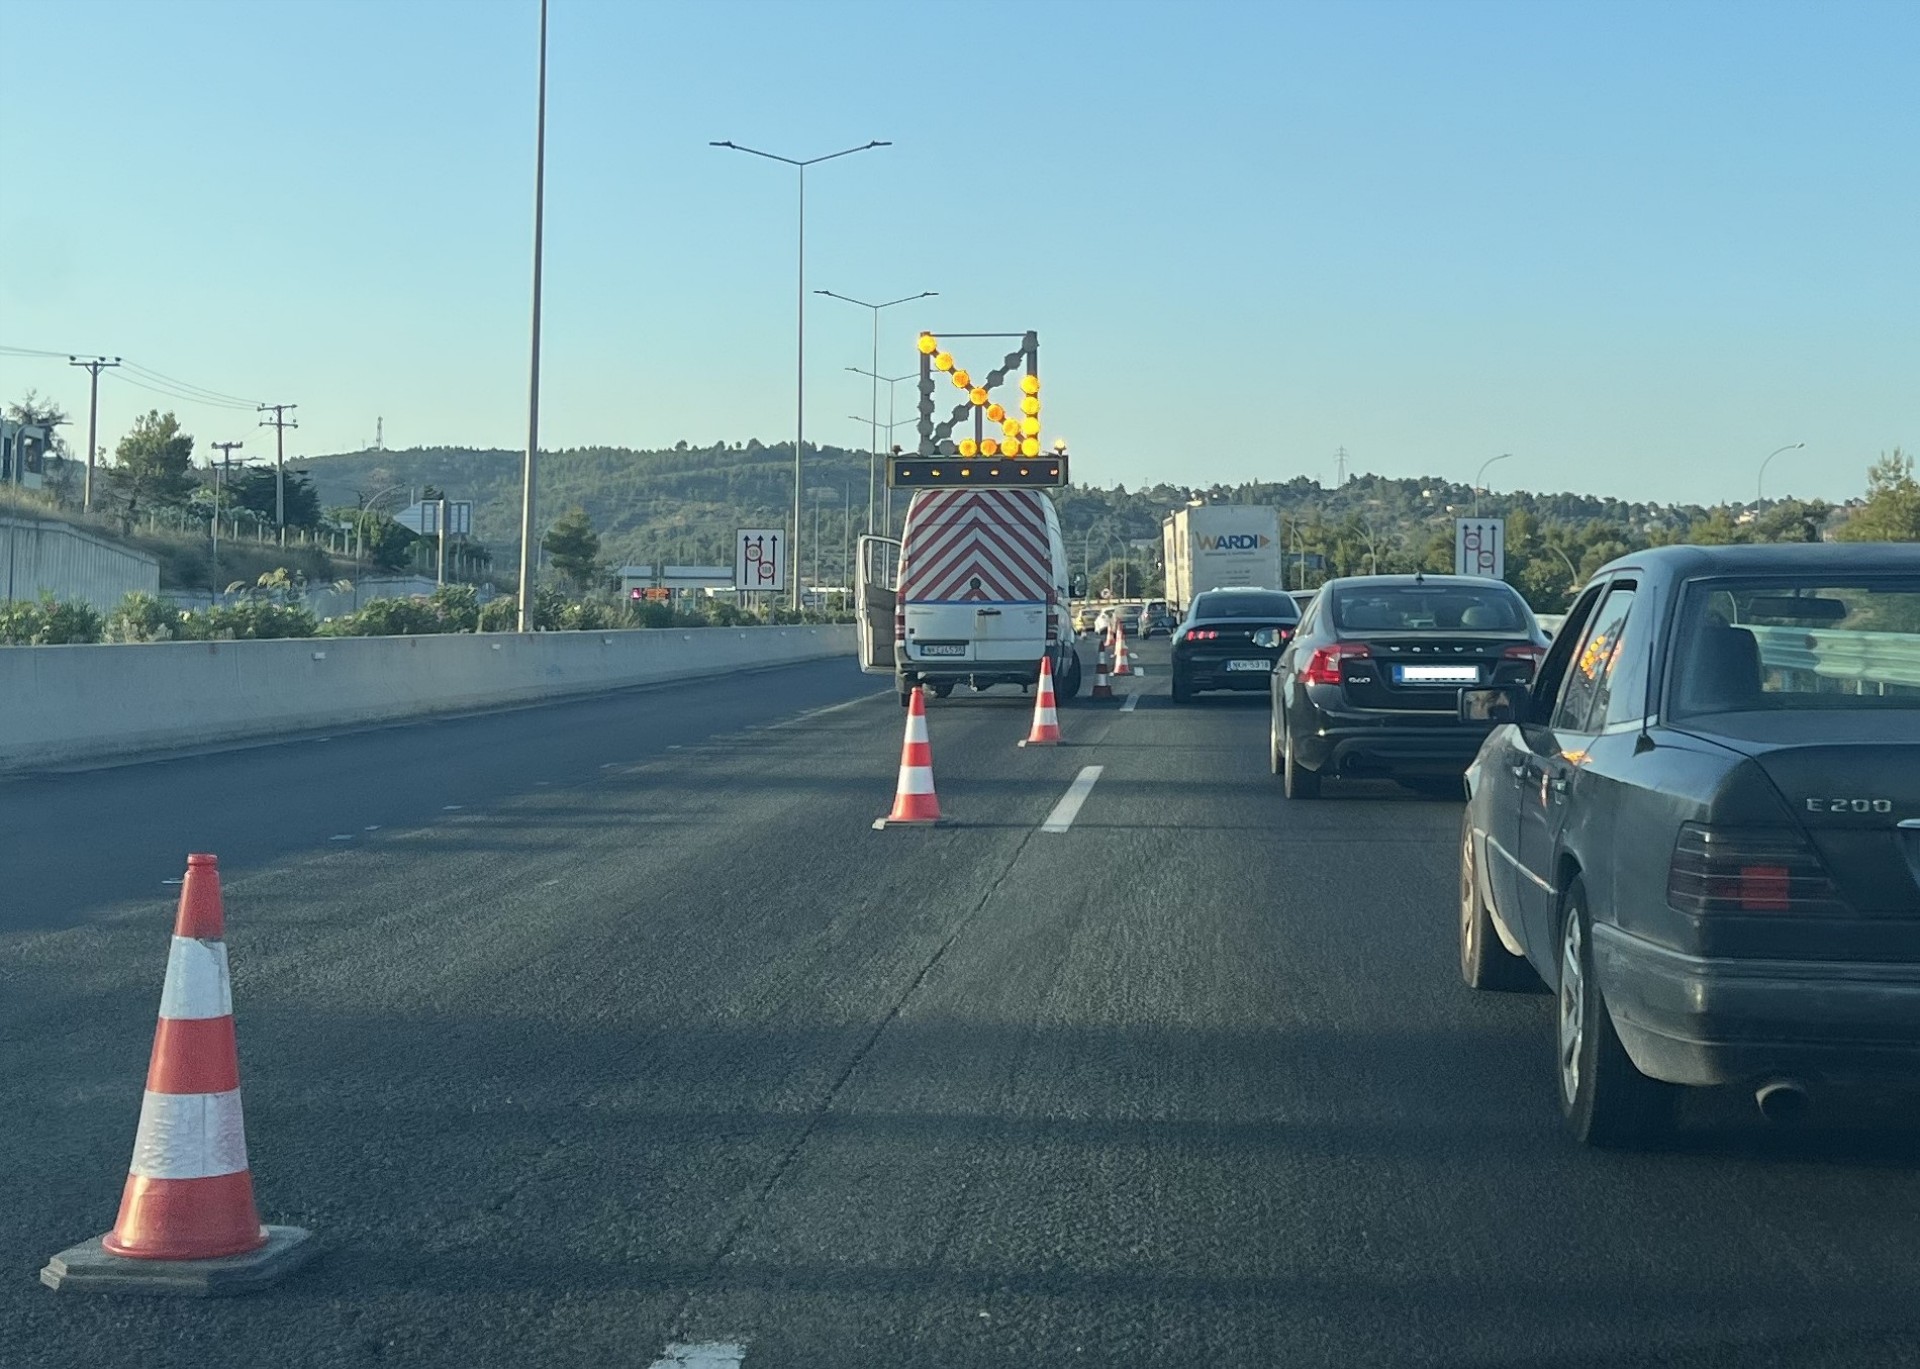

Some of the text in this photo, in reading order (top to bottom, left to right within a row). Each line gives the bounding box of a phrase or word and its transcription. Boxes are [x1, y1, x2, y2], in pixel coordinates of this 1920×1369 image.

[1195, 531, 1258, 551] WARDI
[1806, 798, 1892, 813] E 200
